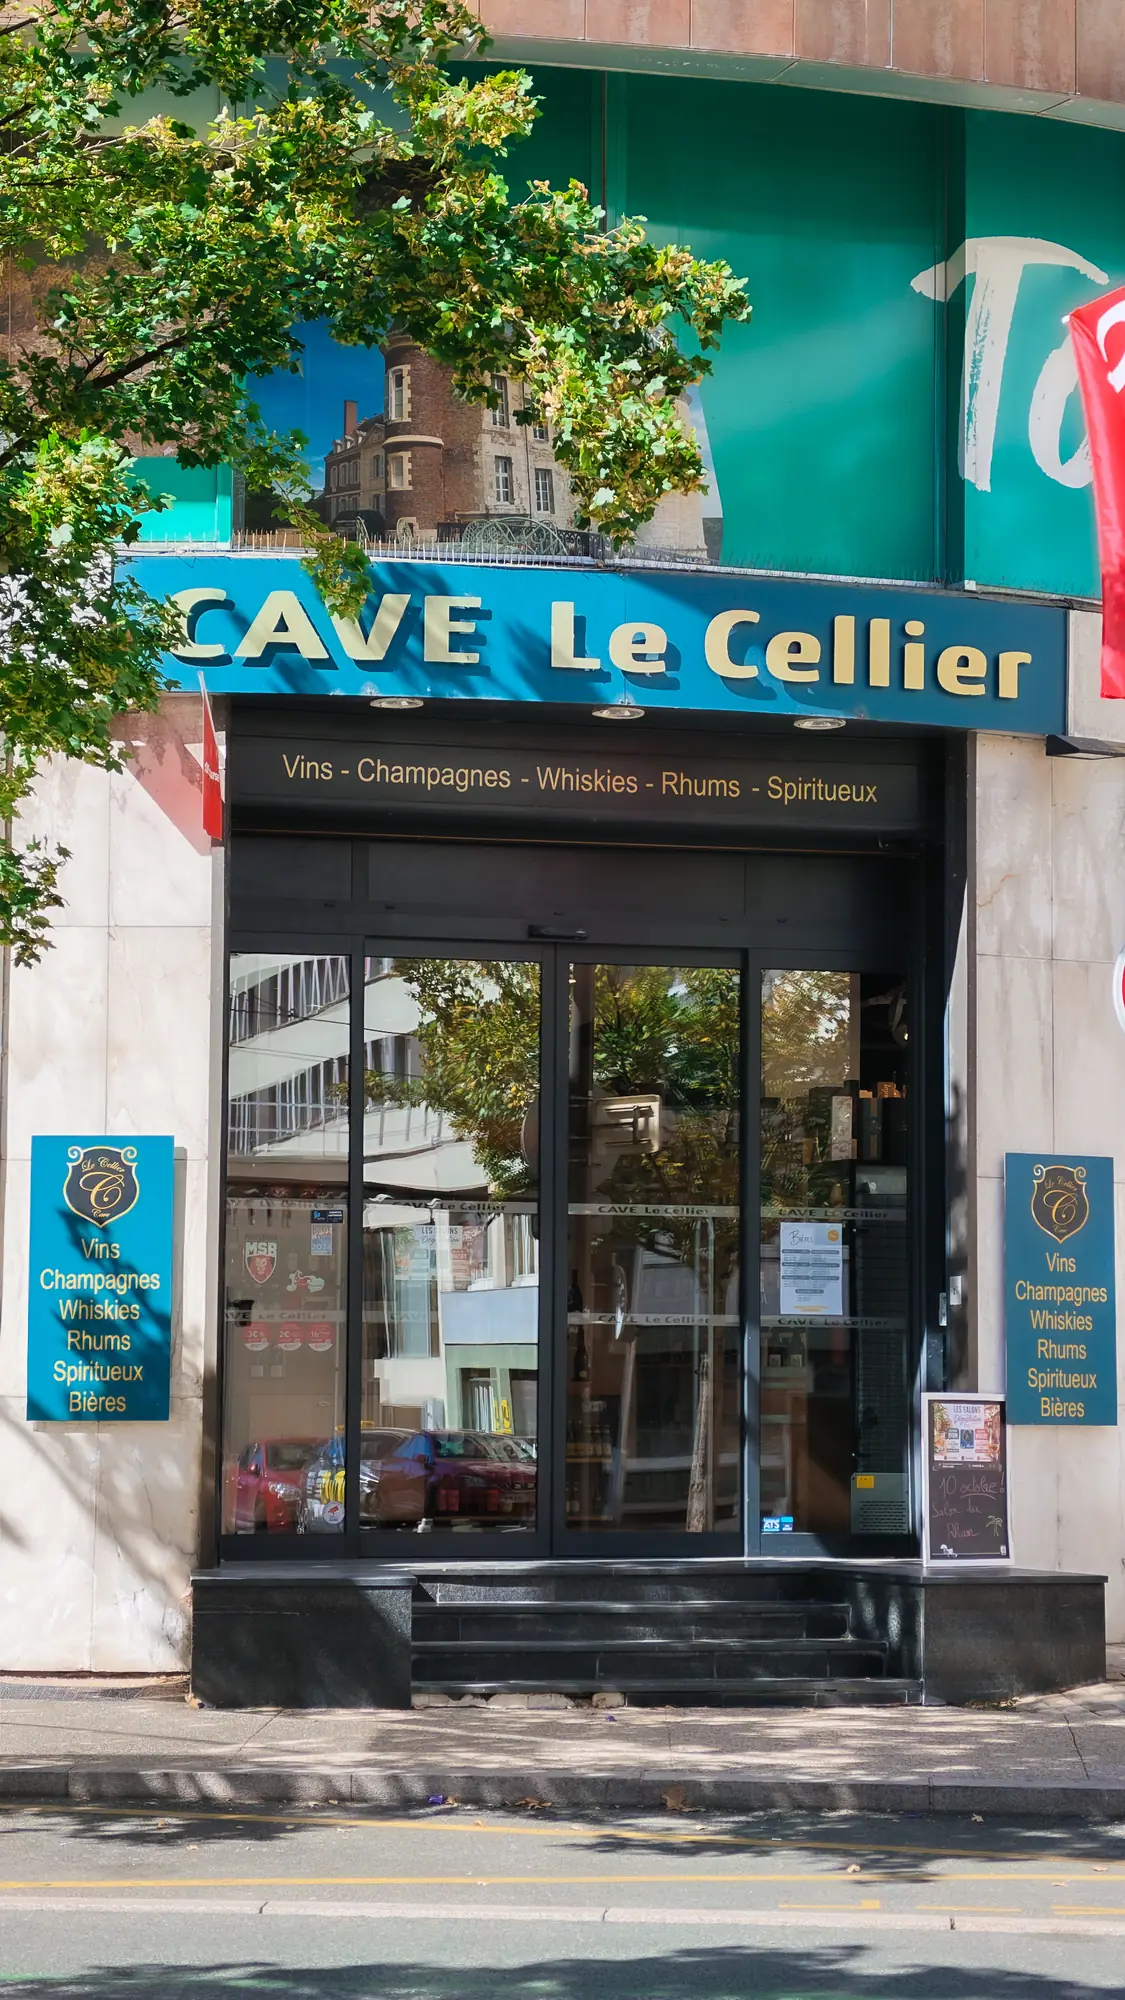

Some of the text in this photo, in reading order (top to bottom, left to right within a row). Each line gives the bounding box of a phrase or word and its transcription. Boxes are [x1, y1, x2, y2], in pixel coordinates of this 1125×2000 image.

[164, 587, 1032, 699] CAVE Le Cellier
[282, 754, 334, 781] Vins
[357, 757, 511, 792] Champagnes
[537, 765, 638, 794] Whiskies
[661, 771, 741, 798] Rhums
[767, 775, 878, 805] Spiritueux
[98, 1156, 126, 1173] Cellier
[598, 1205, 709, 1216] CAVE Le Cellier
[81, 1238, 121, 1260] Vins
[245, 1241, 277, 1257] MSB
[1046, 1252, 1076, 1273] Vins
[40, 1268, 161, 1295] Champagnes
[1015, 1280, 1108, 1307] Champagnes
[59, 1299, 140, 1320] Whiskies
[598, 1314, 638, 1323] CAE
[1030, 1309, 1093, 1331] Whiskies
[67, 1329, 131, 1351] Rhums
[1037, 1339, 1087, 1360] Rhums
[53, 1360, 143, 1387] Spiritueux
[1027, 1367, 1097, 1393] Spiritueux
[69, 1390, 127, 1413] Bières
[1040, 1396, 1085, 1418] Bières
